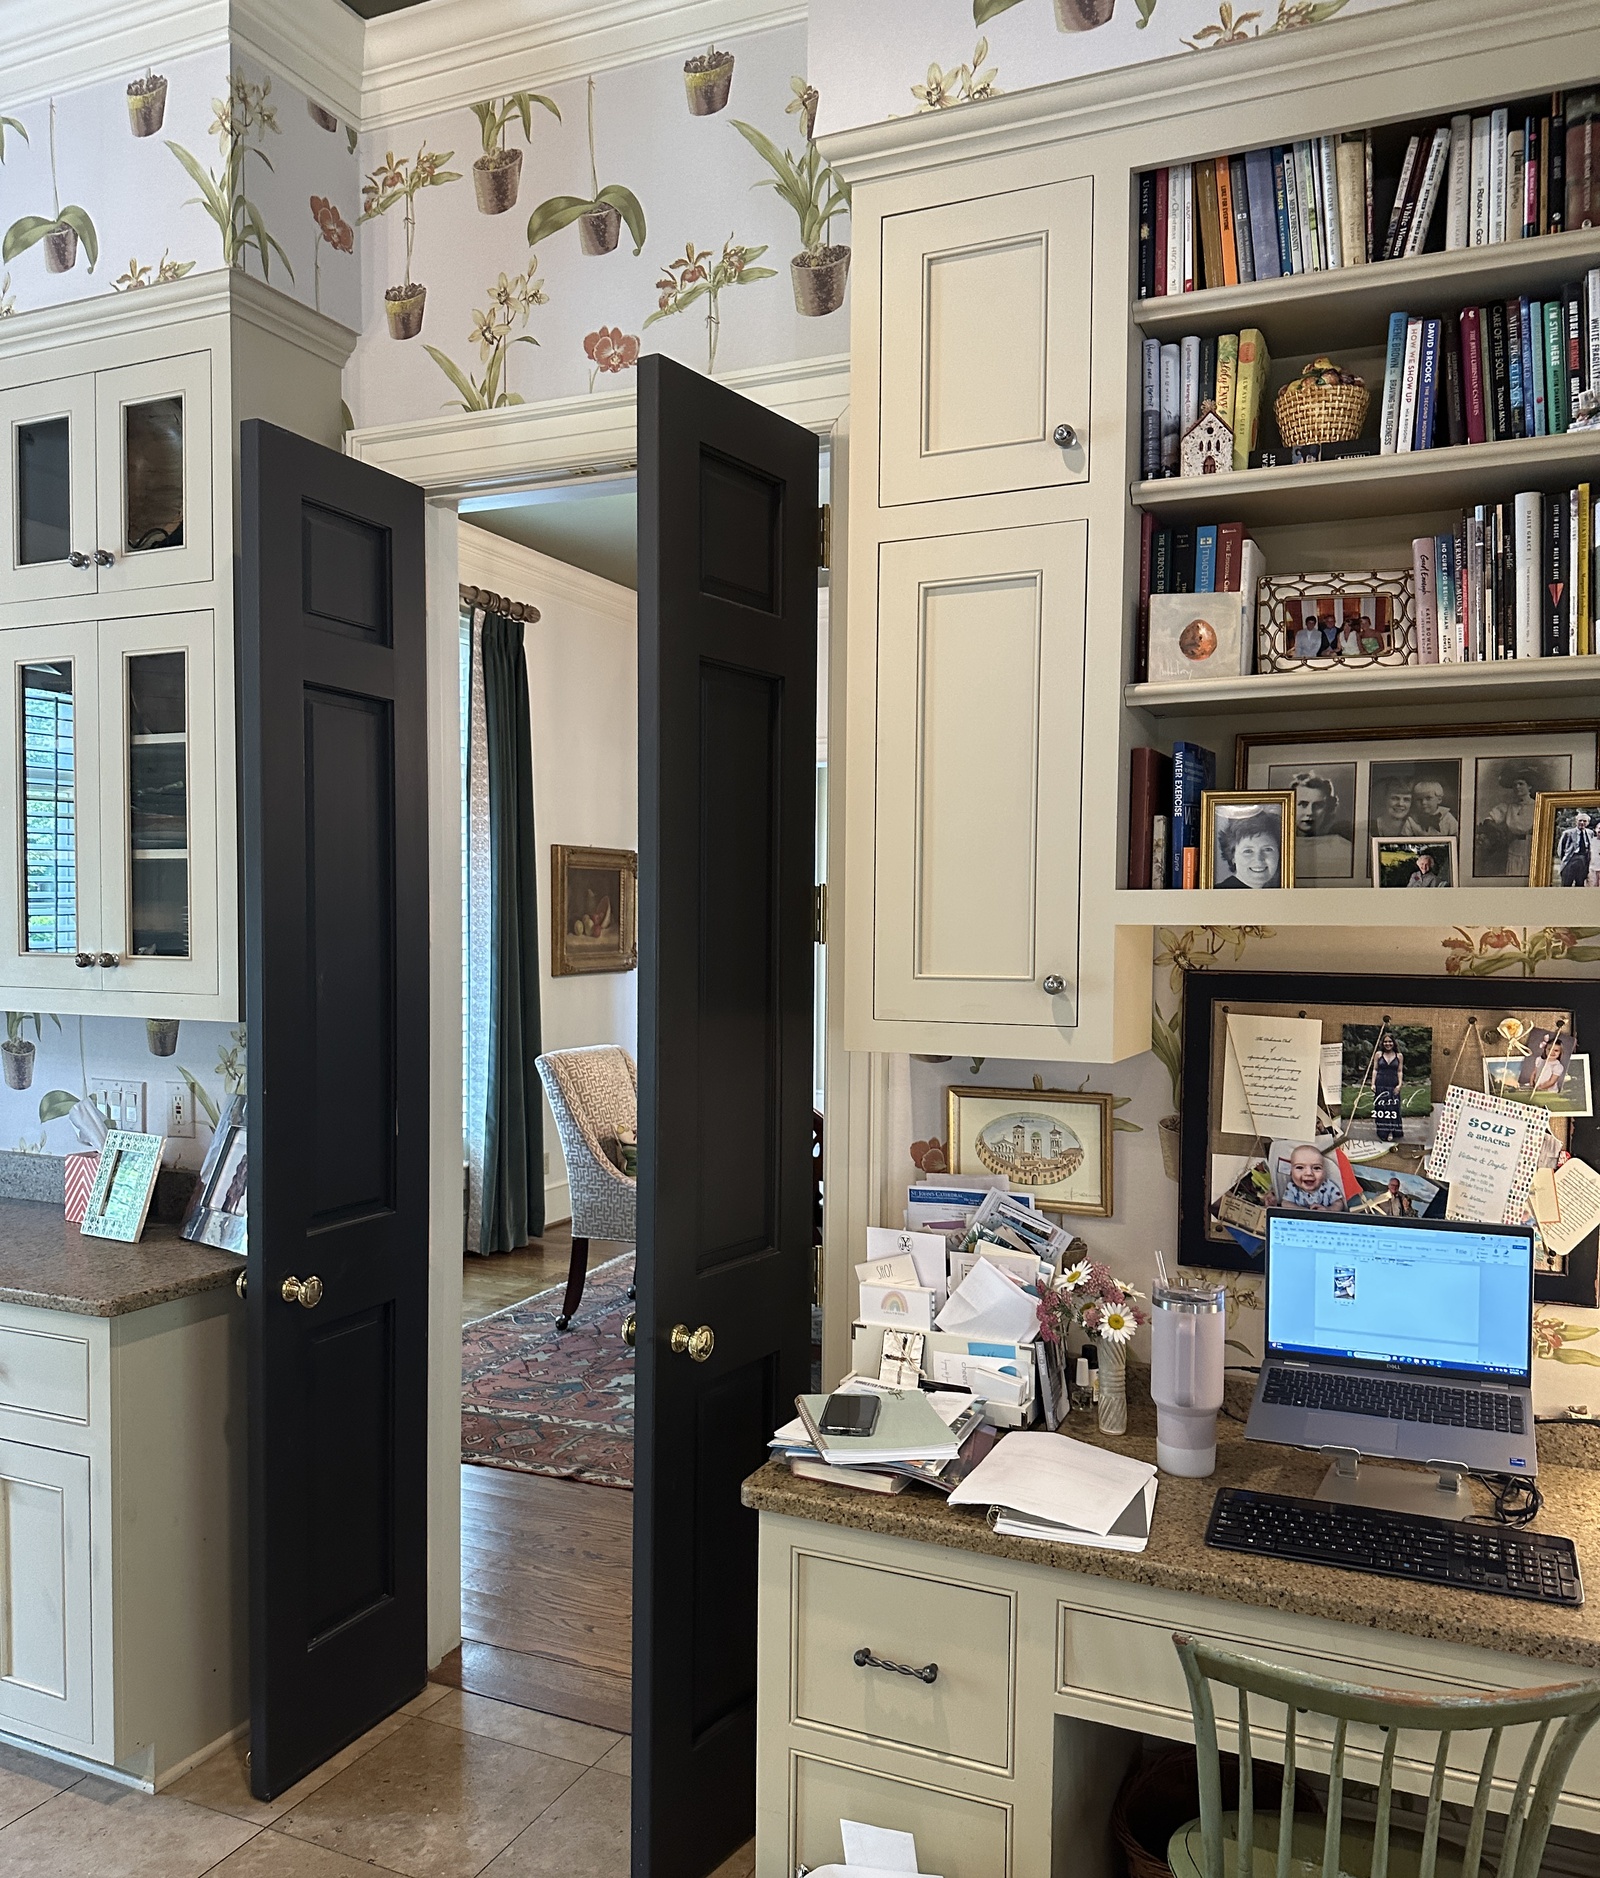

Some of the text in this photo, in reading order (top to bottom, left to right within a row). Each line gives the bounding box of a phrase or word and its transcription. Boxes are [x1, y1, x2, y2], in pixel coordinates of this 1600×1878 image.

[1275, 162, 1284, 176] Tell
[1325, 152, 1333, 173] HOPE
[1456, 146, 1465, 185] BROKEN
[1326, 175, 1333, 185] OF
[1277, 191, 1285, 210] More
[1476, 188, 1484, 218] REASON
[1171, 203, 1182, 241] Christmas
[1290, 215, 1300, 252] CHRISTIANITY
[1393, 202, 1414, 256] White Women
[1569, 301, 1579, 315] HOW
[1509, 315, 1519, 341] WHITE
[1549, 307, 1560, 367] I'M STILL HERE
[1389, 342, 1401, 369] BROWN
[1423, 322, 1436, 383] DAVID BROOKS
[1493, 306, 1504, 380] CARE OF THE SOUL
[1521, 316, 1531, 378] LIGHT WORLD
[1590, 317, 1600, 380] WHITE FRAGILITY
[1217, 359, 1232, 384] Holy
[1405, 328, 1419, 403] HOW WE SHOW UP
[1241, 376, 1249, 404] ALWAYS
[1511, 374, 1522, 407] FENCES
[1383, 379, 1398, 446] BRAVING WILDERNESS
[1421, 397, 1429, 419] SECOND
[1497, 386, 1506, 433] THOMAS MOORE
[1239, 413, 1247, 436] GUEST
[1420, 420, 1428, 450] MOUNTAIN
[1553, 515, 1560, 523] IN
[1225, 540, 1233, 552] THE
[1441, 543, 1447, 553] NO
[1454, 538, 1462, 571] SERMON
[1157, 547, 1165, 579] PURPOSE
[1202, 549, 1210, 586] TIMOTHY
[1420, 554, 1429, 571] Good
[1552, 568, 1560, 581] LOVE
[1552, 615, 1560, 638] BOB GOFF
[1174, 751, 1183, 817] WATER EXERCISE
[1354, 1088, 1426, 1109] Class of
[1370, 1110, 1398, 1119] 2023
[1468, 1117, 1516, 1137] SOUP
[1475, 1133, 1511, 1148] SNACKS
